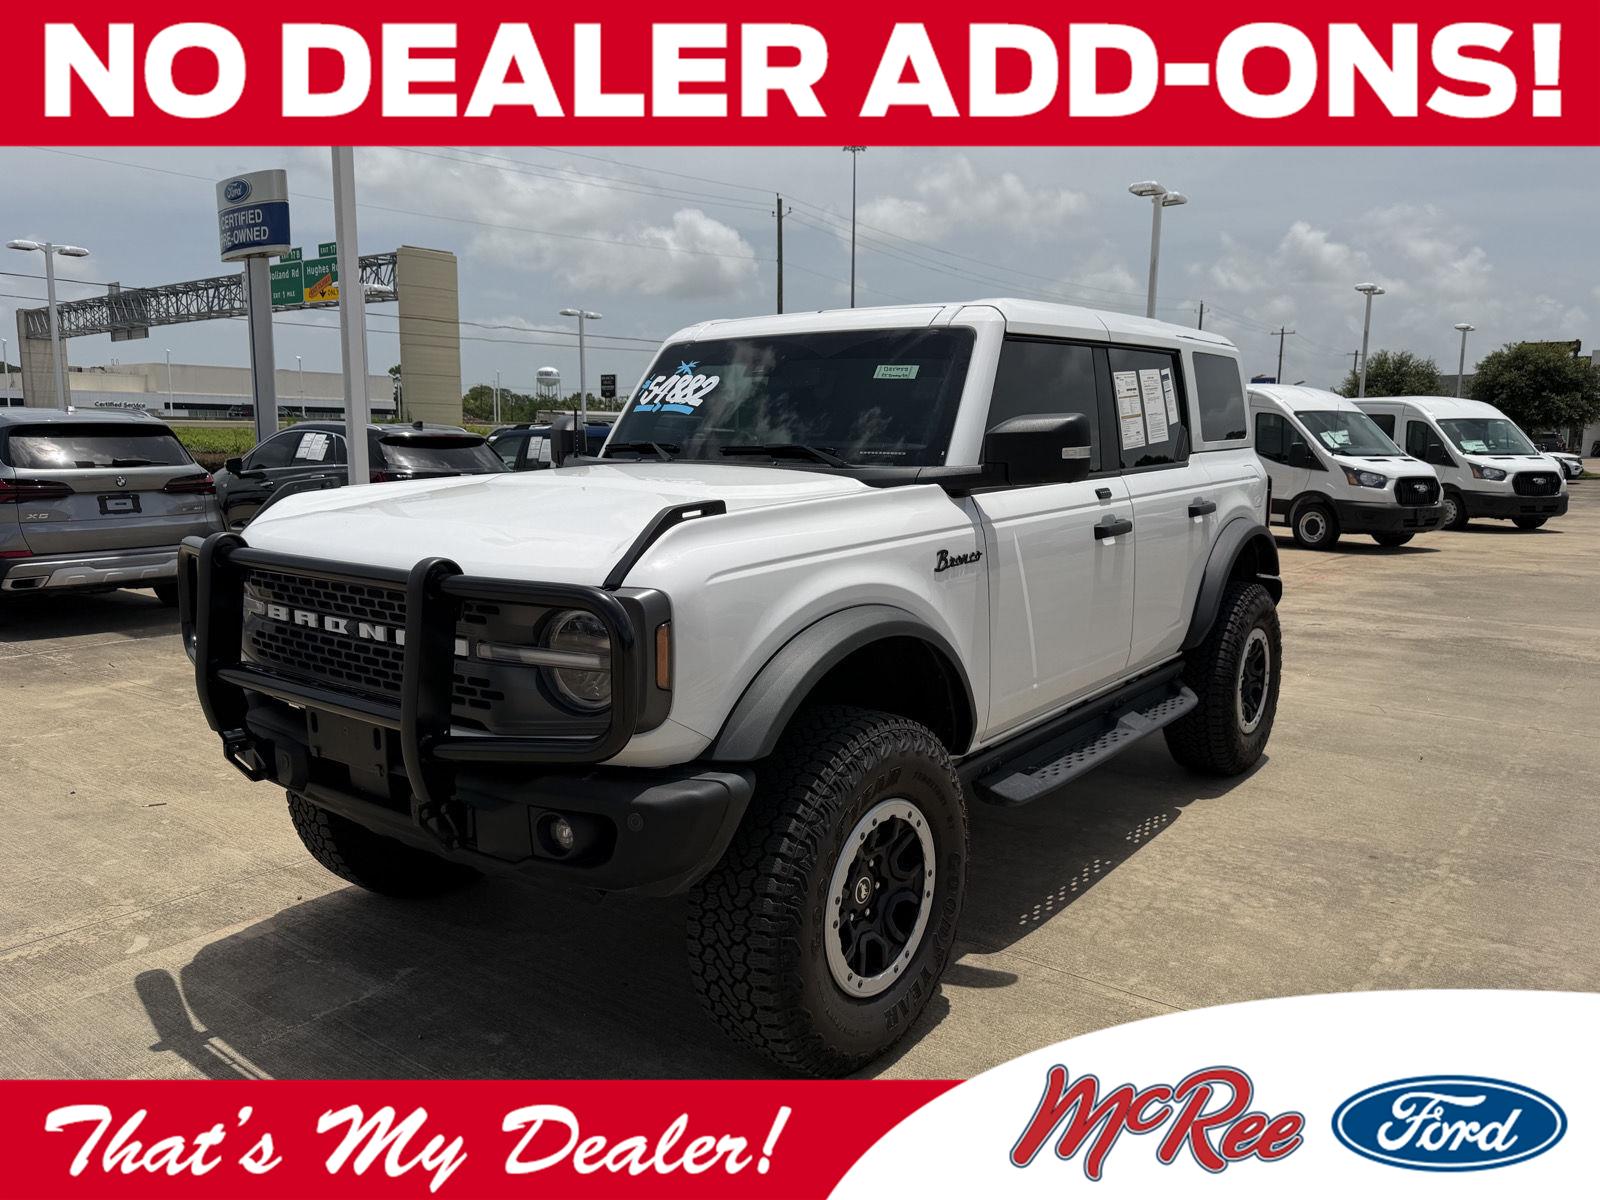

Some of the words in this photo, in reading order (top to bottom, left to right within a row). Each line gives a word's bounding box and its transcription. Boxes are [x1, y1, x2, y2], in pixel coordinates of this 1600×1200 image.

[291, 268, 300, 278] Rd
[306, 265, 330, 276] Hughes
[123, 402, 146, 410] Service
[933, 549, 983, 573] Bronco
